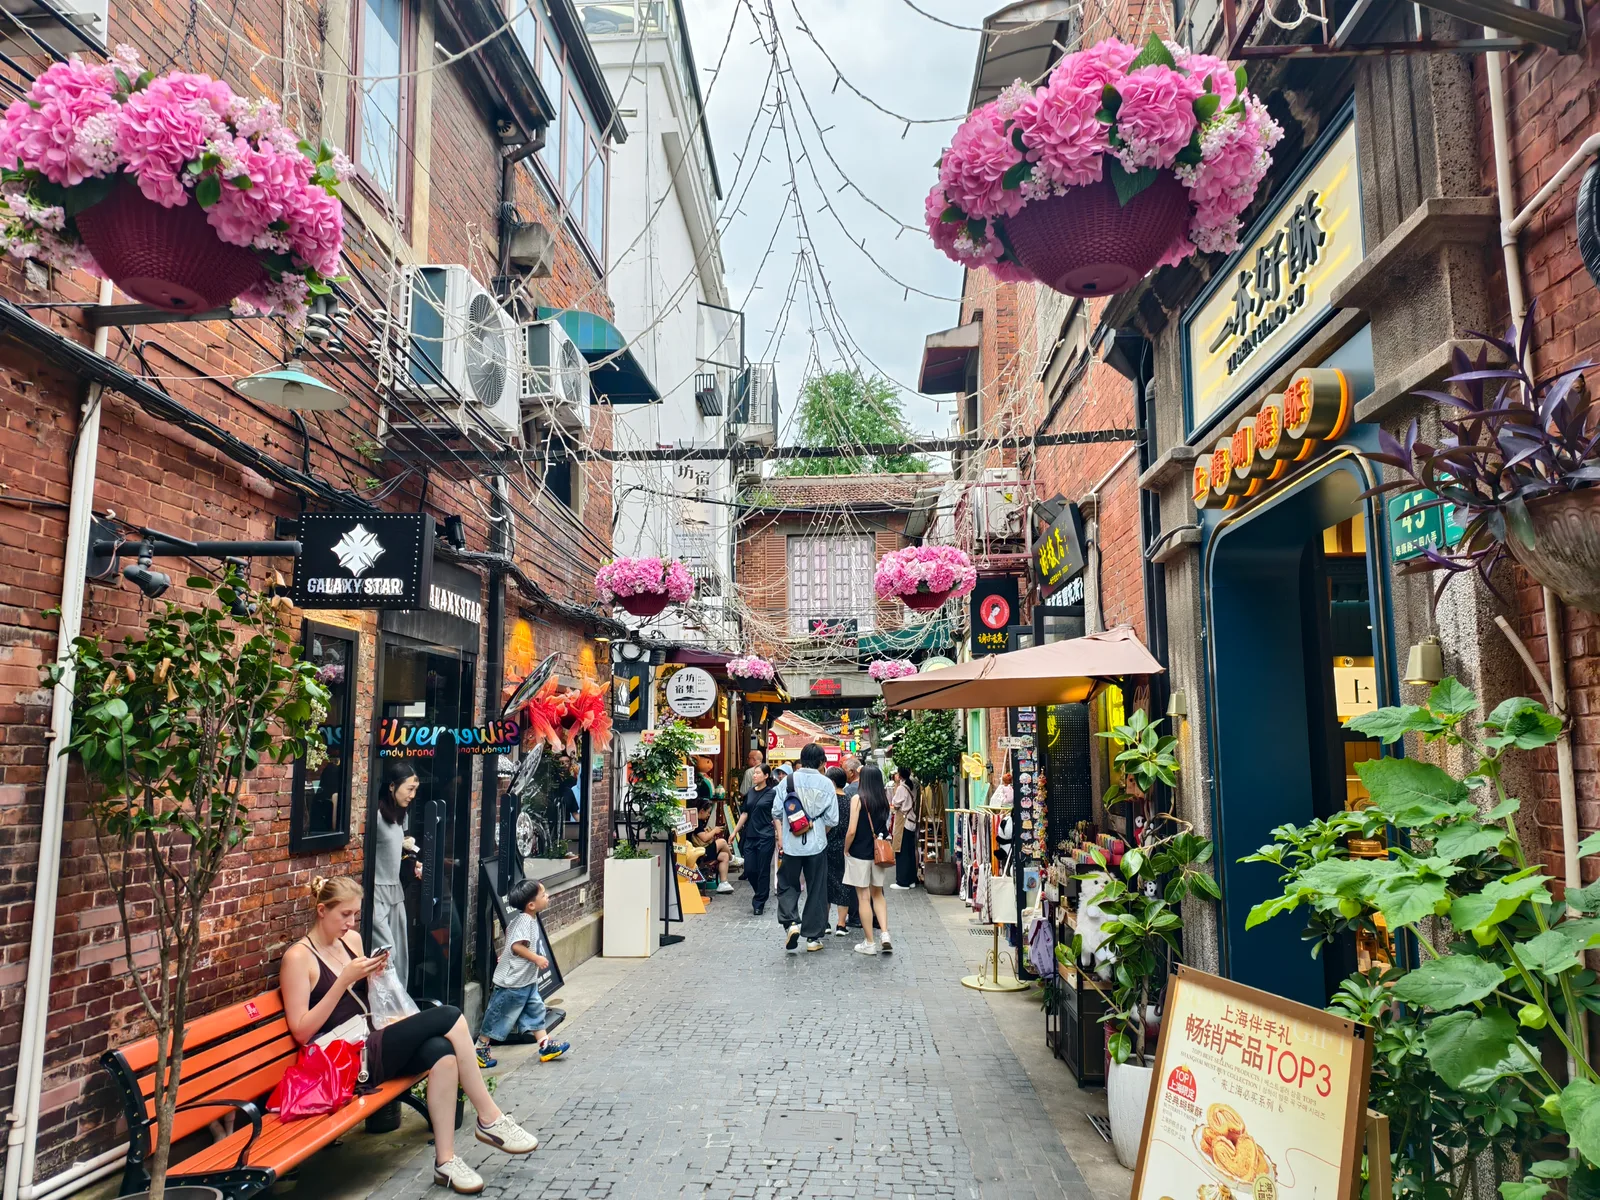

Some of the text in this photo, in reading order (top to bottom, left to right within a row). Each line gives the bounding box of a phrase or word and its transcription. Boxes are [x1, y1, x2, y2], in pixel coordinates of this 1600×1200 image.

[1209, 190, 1326, 353] 一本好酥
[1191, 376, 1310, 501] 上海蝴蝶酥
[1401, 492, 1426, 533] 45
[307, 578, 404, 595] GALAXY STAR
[428, 584, 482, 624] ALAXYSTAR
[675, 685, 695, 694] 宿集
[1343, 678, 1373, 704] 上
[379, 718, 447, 746] ilver
[379, 746, 435, 758] endy brand
[1220, 1004, 1292, 1046] 上海伴手礼
[1214, 1056, 1235, 1071] SELLING
[1234, 1063, 1261, 1082] PRODUCTS
[1226, 1070, 1258, 1089] COLLECTION
[1169, 1079, 1195, 1100] 上海限定
[1221, 1078, 1274, 1112] 来上海必买系列
[1164, 1092, 1203, 1118] 经典蝴蝶酥
